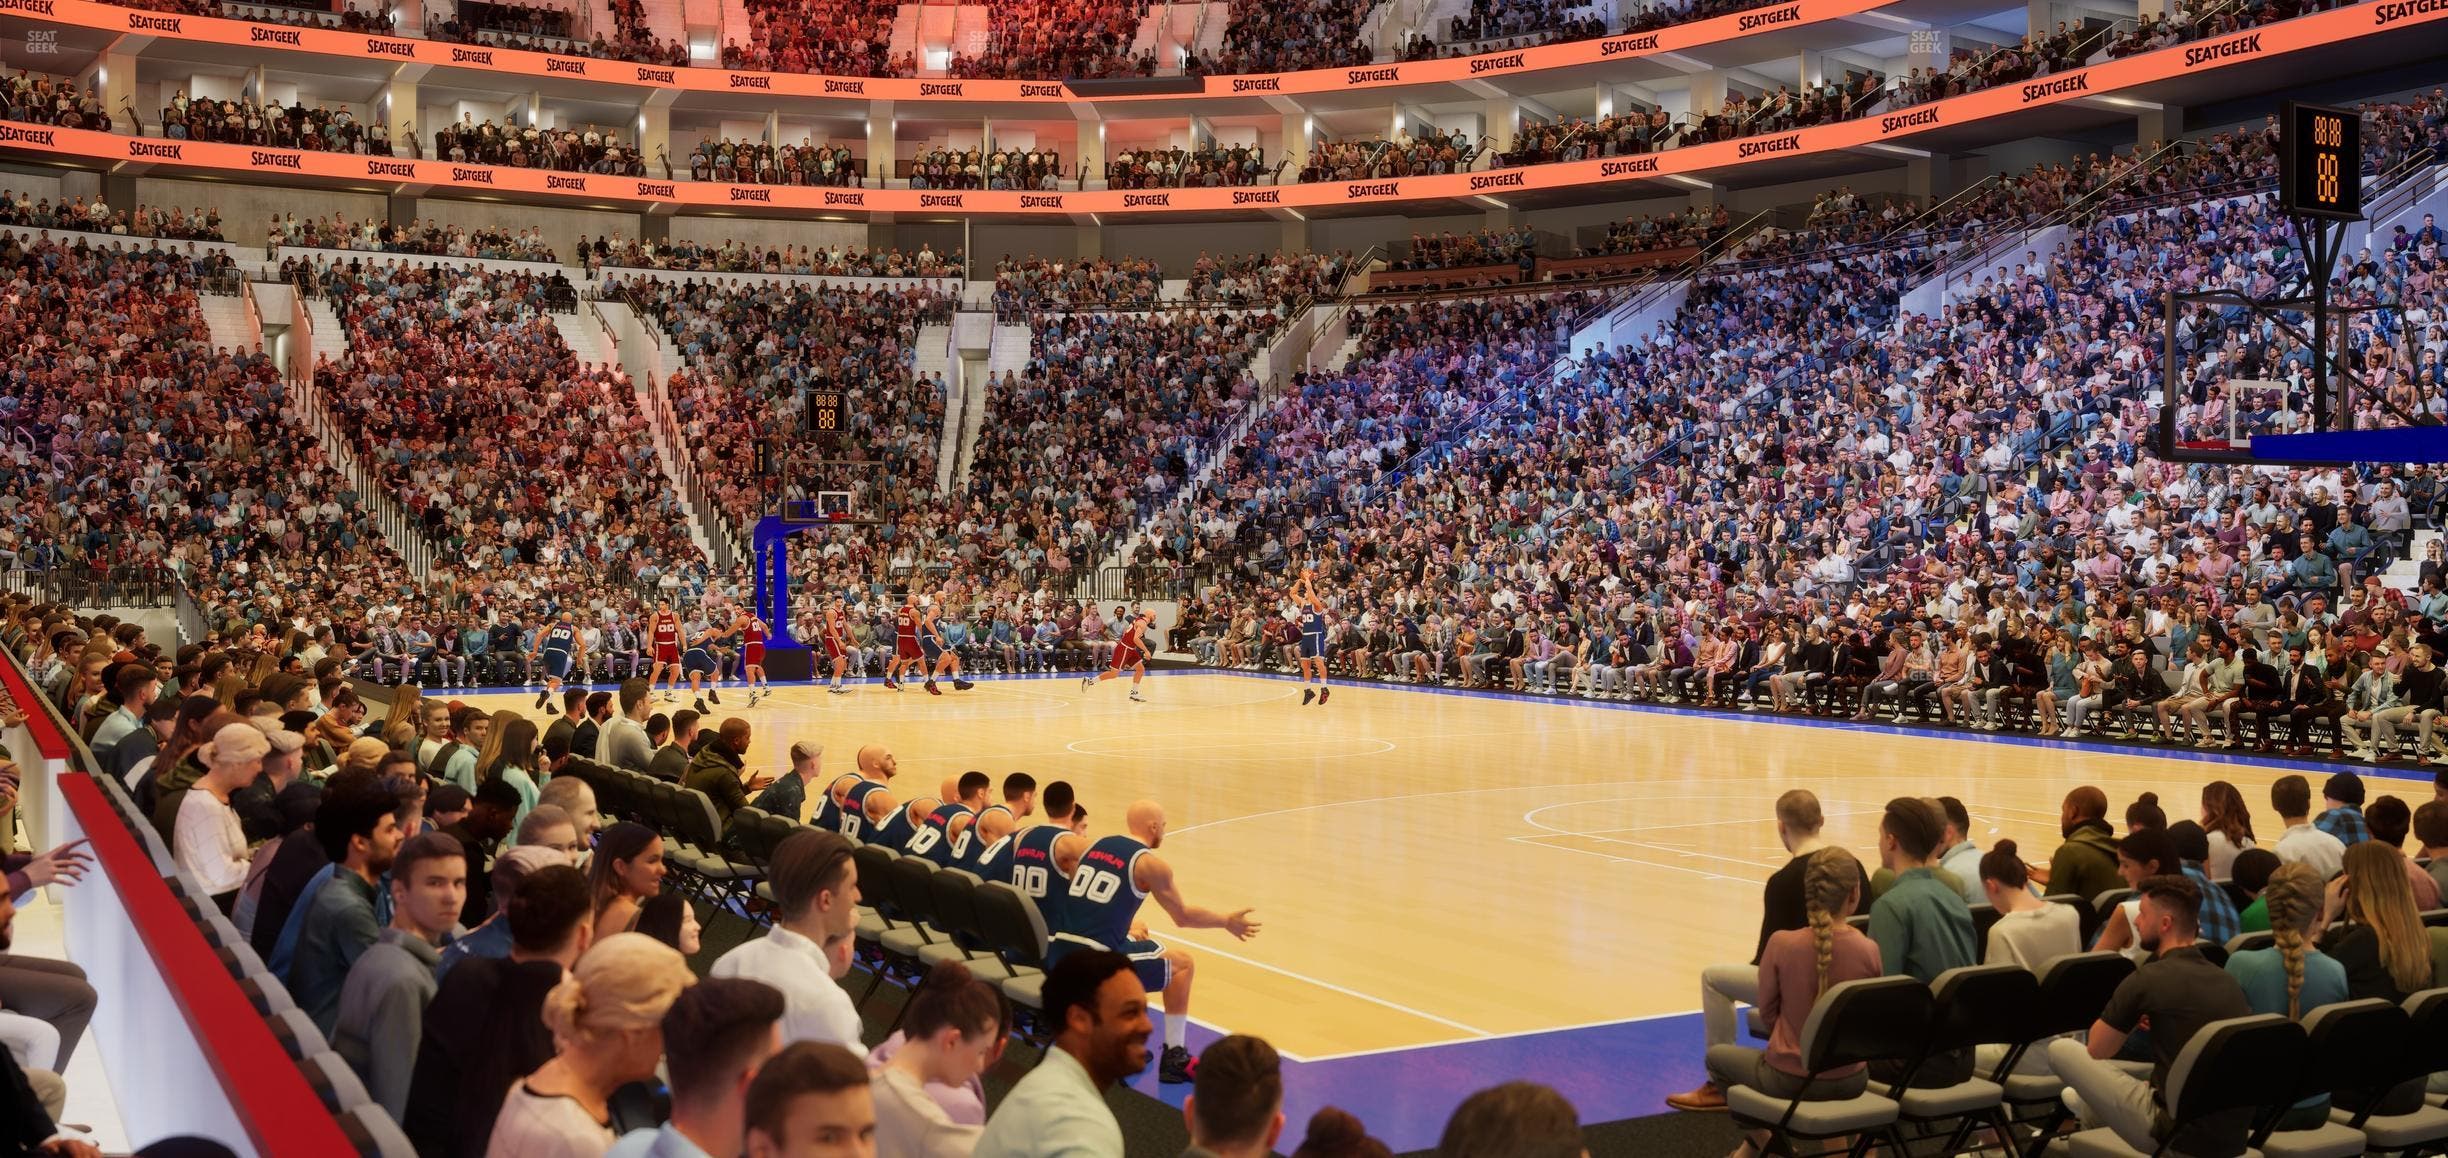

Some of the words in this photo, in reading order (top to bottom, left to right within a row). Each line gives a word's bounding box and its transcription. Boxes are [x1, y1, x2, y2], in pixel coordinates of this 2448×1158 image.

[129, 14, 181, 33] SEATGEEK
[1739, 5, 1800, 31] SEATGEEK
[251, 27, 300, 45] SEATGEEK
[368, 39, 414, 57] SEATGEEK
[1602, 34, 1658, 56] SEATGEEK
[2186, 33, 2261, 67] SEATGEEK
[453, 48, 492, 65] SEATGEEK
[1471, 54, 1524, 73] SEATGEEK
[547, 58, 585, 75] SEATGEEK
[638, 68, 674, 84] SEATGEEK
[731, 75, 770, 89] SEATGEEK
[1233, 77, 1280, 92] SEATGEEK
[1349, 68, 1399, 84] SEATGEEK
[825, 80, 863, 94] SEATGEEK
[921, 83, 962, 96] SEATGEEK
[1021, 85, 1062, 97] SEATGEEK
[2023, 73, 2088, 102] SEATGEEK
[1882, 106, 1938, 133] SEATGEEK
[2314, 116, 2327, 145] 88
[2329, 118, 2341, 147] 88
[130, 141, 181, 160] SEATGEEK
[1739, 135, 1800, 158] SEATGEEK
[252, 151, 301, 169] SEATGEEK
[1601, 157, 1658, 176] SEATGEEK
[368, 161, 415, 178] SEATGEEK
[453, 168, 492, 184] SEATGEEK
[2318, 153, 2338, 203] 88
[548, 176, 585, 191] SEATGEEK
[1471, 172, 1524, 190] SEATGEEK
[638, 183, 674, 198] SEATGEEK
[731, 188, 770, 202] SEATGEEK
[825, 192, 863, 205] SEATGEEK
[1233, 190, 1279, 204] SEATGEEK
[1349, 183, 1398, 198] SEATGEEK
[921, 195, 962, 207] SEATGEEK
[1021, 196, 1062, 208] SEATGEEK
[1124, 194, 1169, 207] SEATGEEK
[816, 394, 826, 407] 88
[827, 394, 838, 407] 88
[818, 409, 835, 429] 88
[551, 628, 571, 640] 00
[658, 623, 675, 633] 00
[1068, 864, 1121, 904] 00
